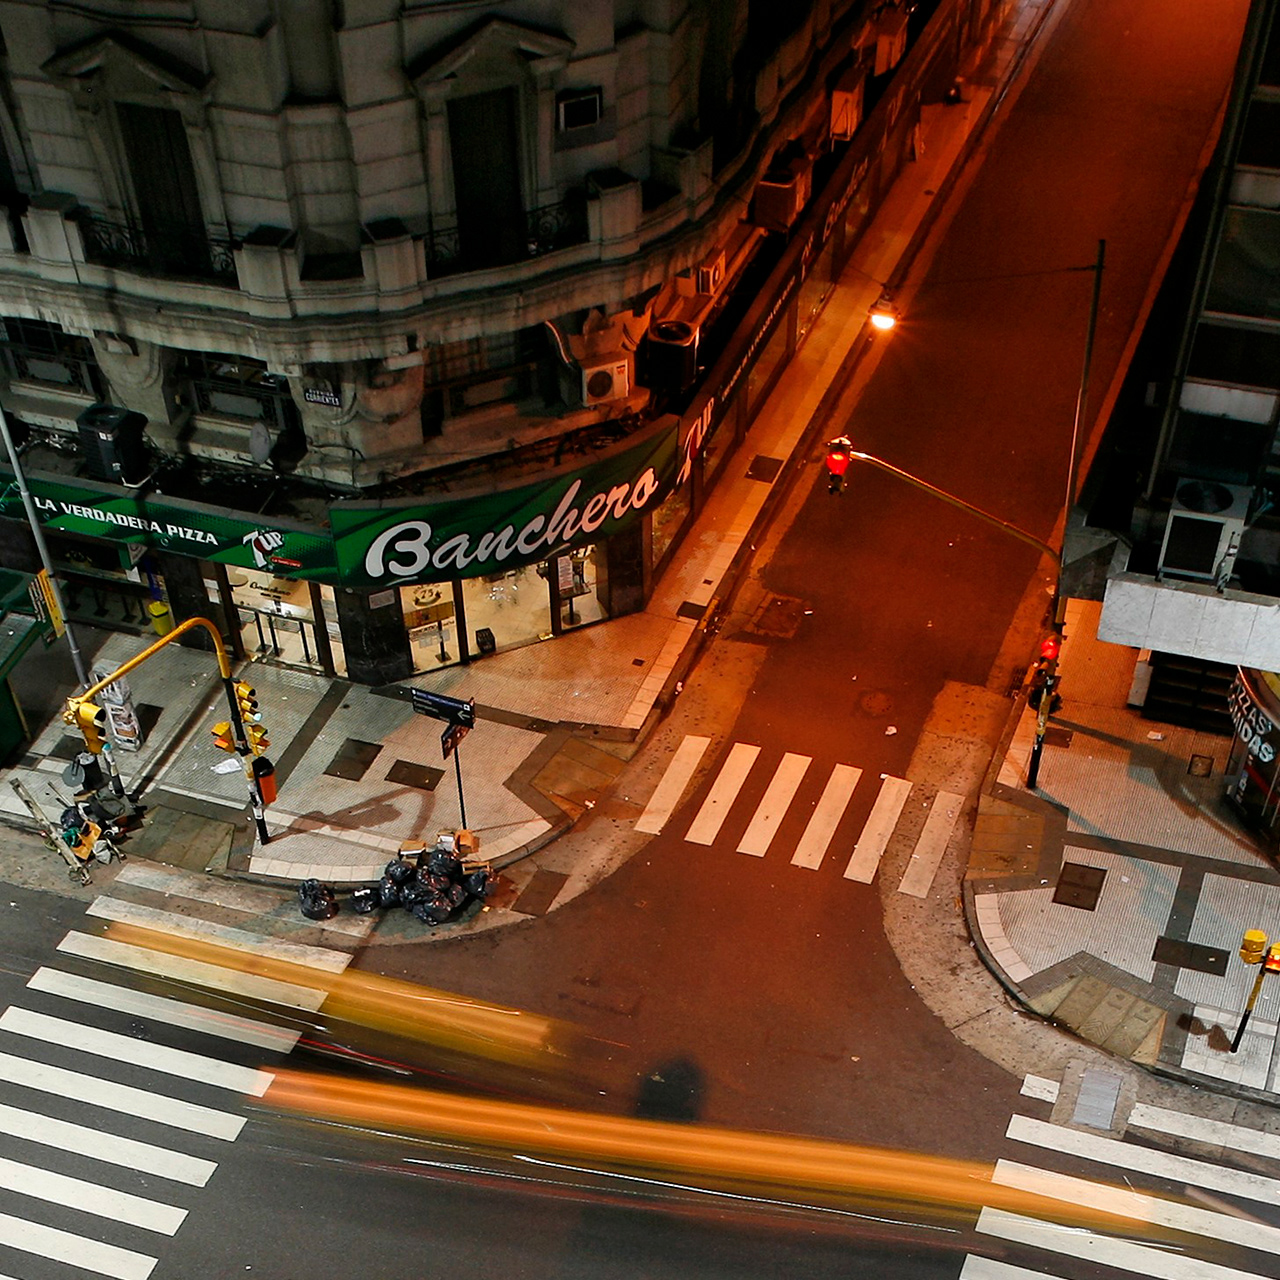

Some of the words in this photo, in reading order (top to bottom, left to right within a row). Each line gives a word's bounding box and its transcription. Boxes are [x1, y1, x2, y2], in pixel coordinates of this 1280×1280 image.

[34, 497, 58, 513] LA
[60, 501, 164, 535] VERDADERA
[166, 523, 220, 547] PIZZA
[365, 467, 660, 578] Banchero
[242, 528, 286, 569] 7UP
